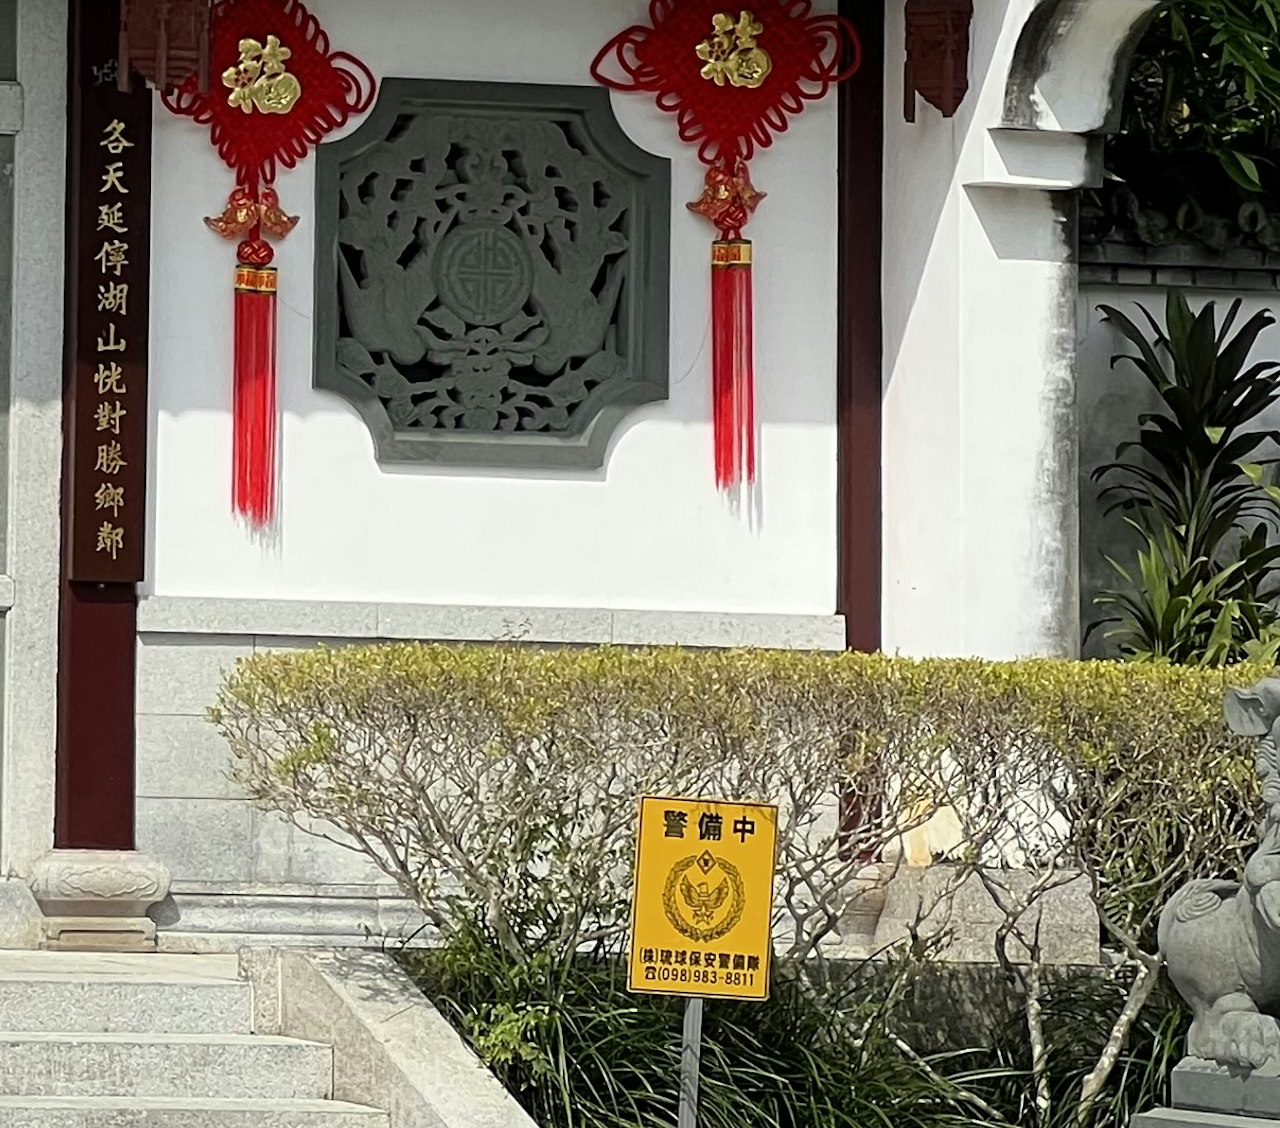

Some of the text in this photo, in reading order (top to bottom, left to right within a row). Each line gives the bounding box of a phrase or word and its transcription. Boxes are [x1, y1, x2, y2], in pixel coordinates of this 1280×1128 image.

[221, 34, 302, 115] 福
[694, 9, 773, 89] 福
[663, 809, 755, 843] 警備中
